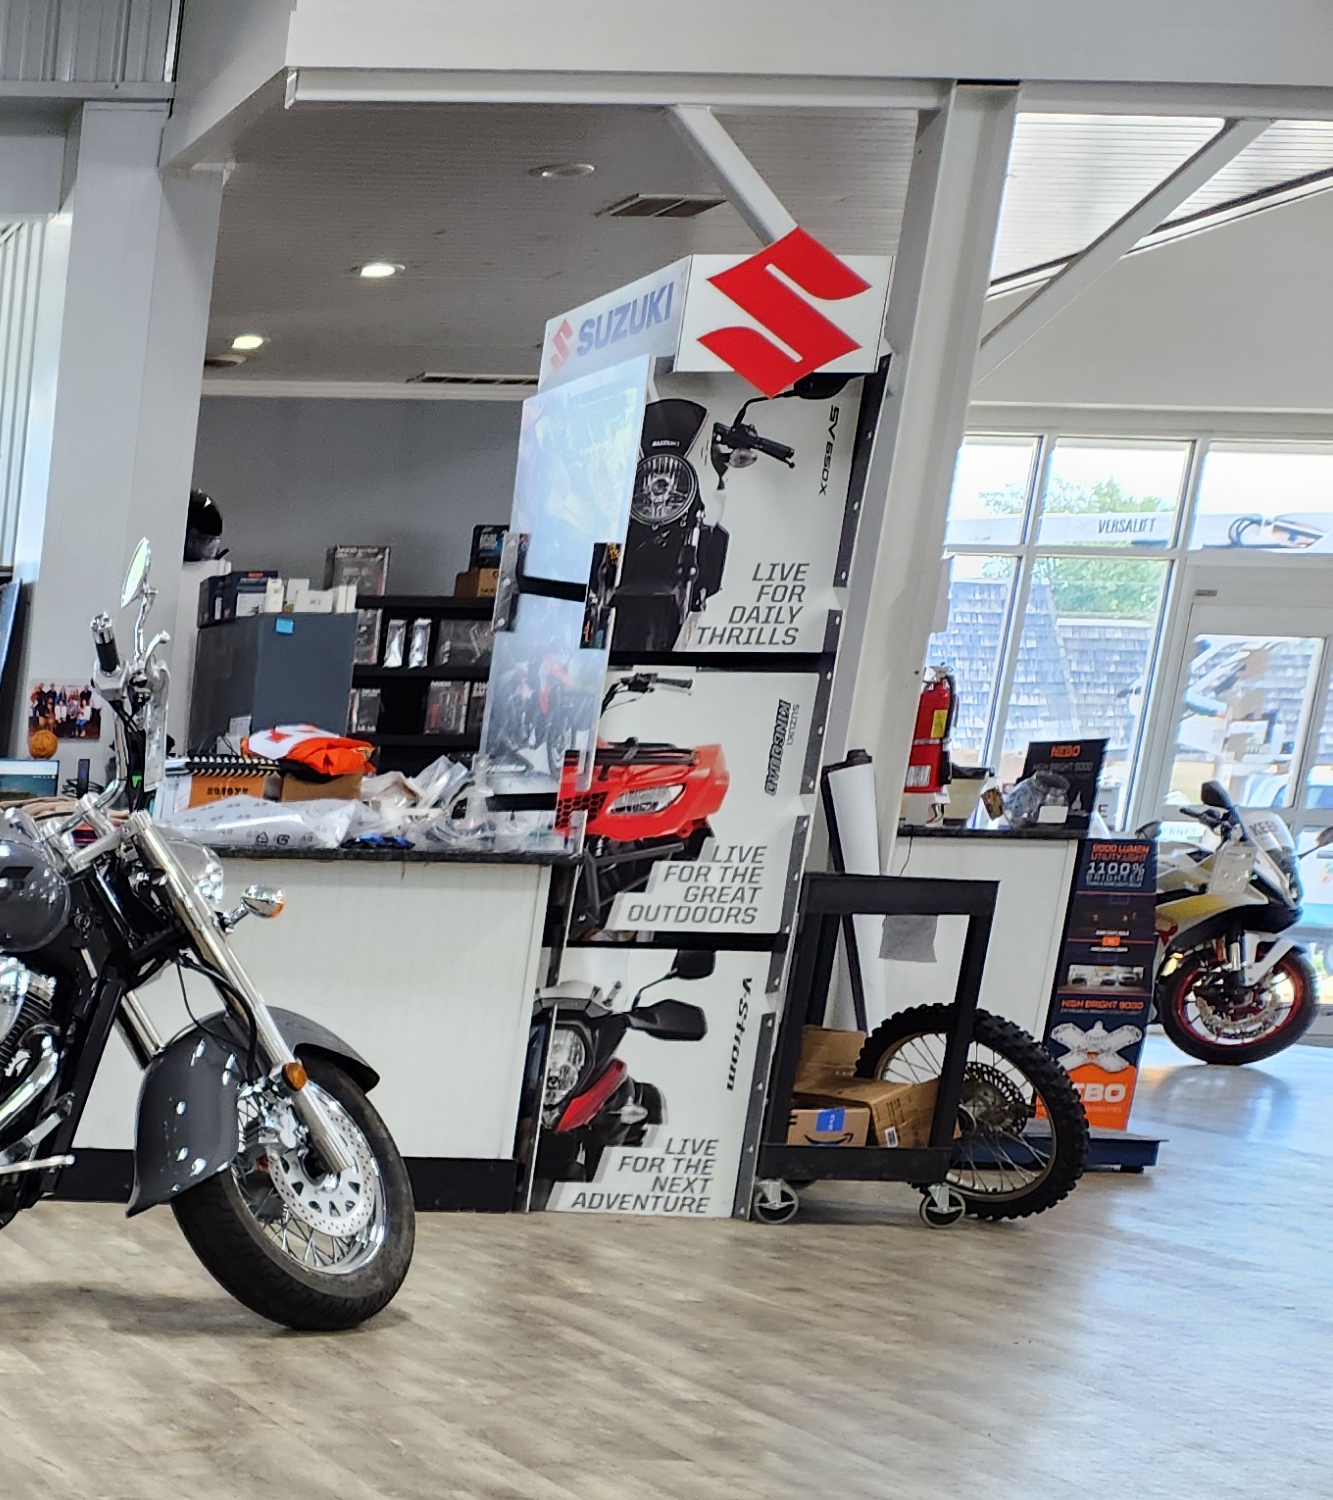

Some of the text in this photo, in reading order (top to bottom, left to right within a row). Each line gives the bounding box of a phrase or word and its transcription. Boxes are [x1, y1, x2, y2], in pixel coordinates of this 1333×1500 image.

[576, 281, 674, 357] SUZUKI
[751, 563, 810, 582] LIVE
[756, 585, 806, 603] FOR
[728, 606, 803, 624] DAILY
[697, 627, 800, 646] THRILLS
[712, 845, 767, 864] LIVE
[664, 865, 764, 884] FOR THE
[1087, 862, 1146, 875] 1100%
[684, 885, 763, 904] GREAT
[627, 904, 759, 925] OUTDOORS
[1072, 1083, 1126, 1103] BO
[665, 1137, 719, 1156] LIVE
[617, 1156, 716, 1175] FOR THE
[651, 1176, 713, 1194] NEXT
[571, 1192, 710, 1214] ADVENTURE
